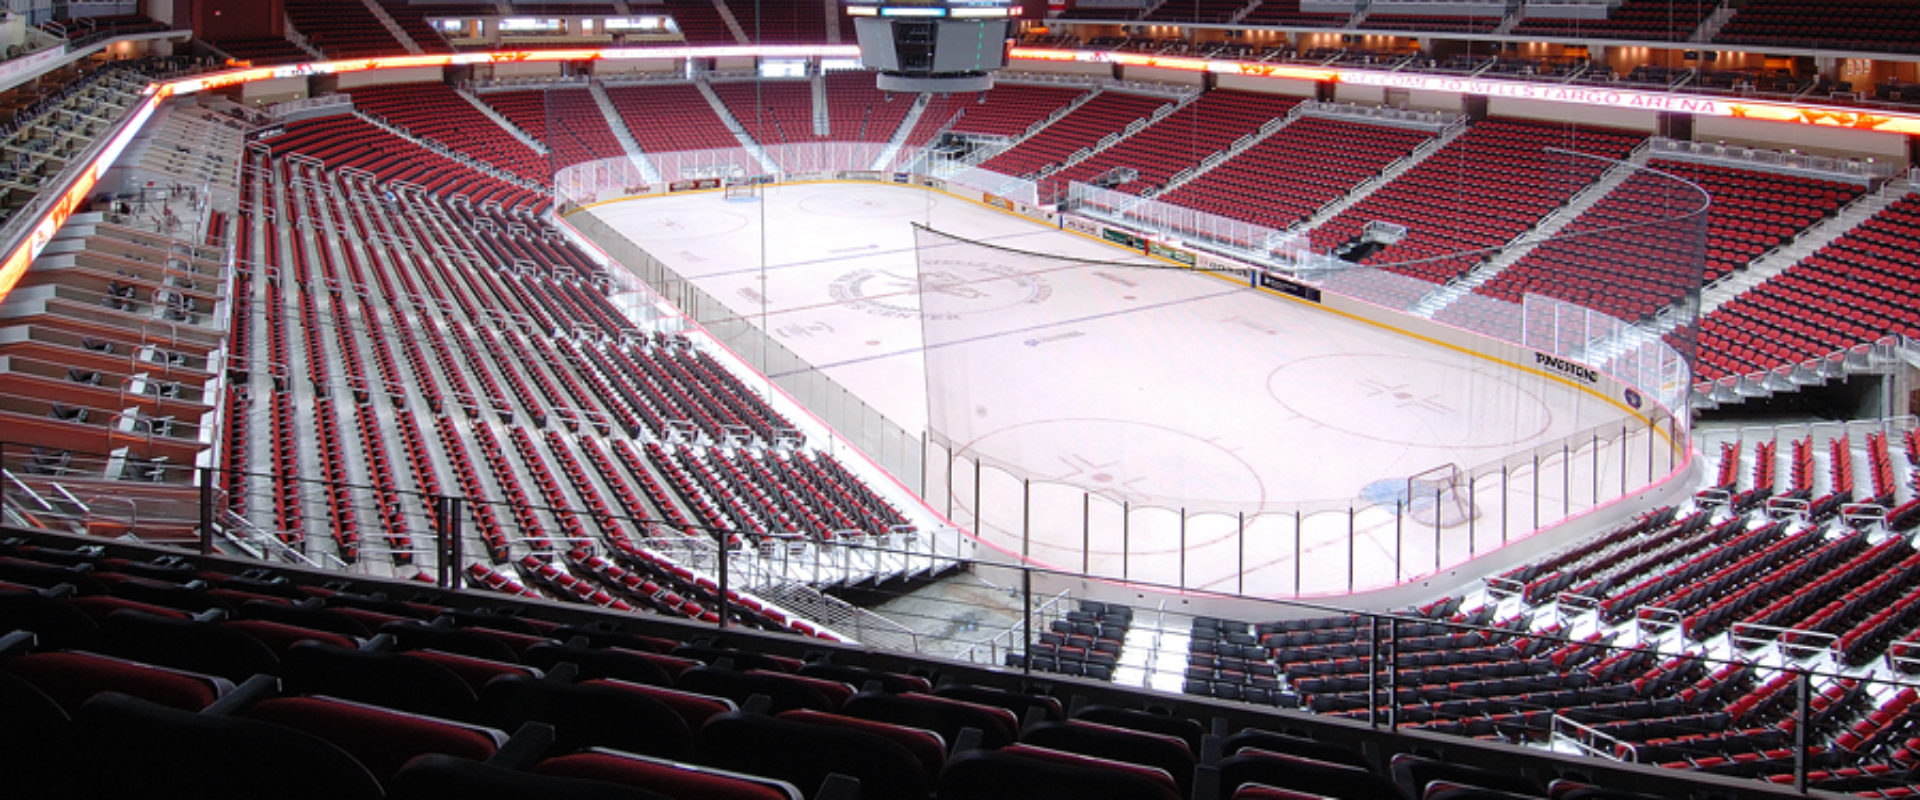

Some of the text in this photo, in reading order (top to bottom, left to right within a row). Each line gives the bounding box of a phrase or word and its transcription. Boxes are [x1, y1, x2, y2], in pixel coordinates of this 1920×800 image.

[1347, 73, 1716, 112] WELCOME TO WELLS FARGO ARENA
